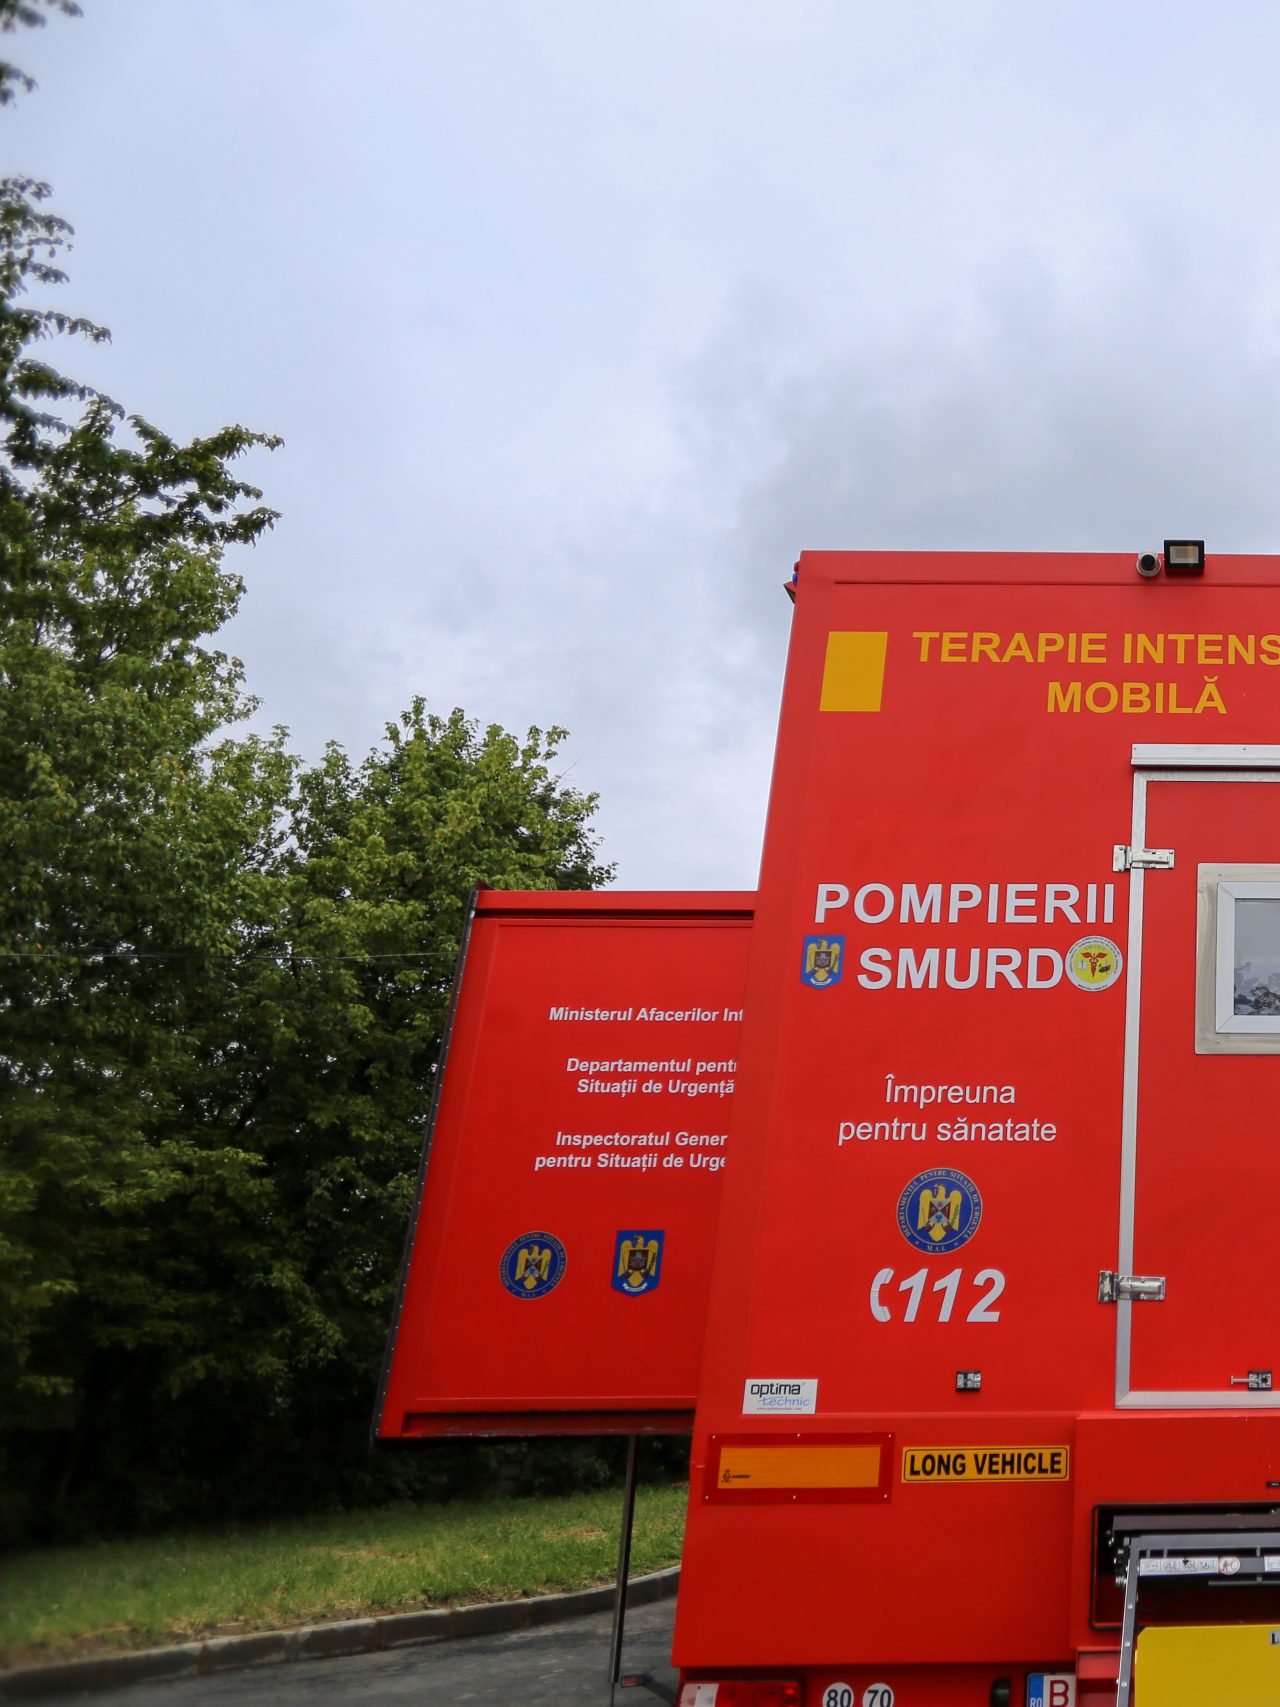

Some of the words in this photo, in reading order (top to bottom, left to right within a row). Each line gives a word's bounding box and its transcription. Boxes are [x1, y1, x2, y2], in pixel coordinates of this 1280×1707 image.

[912, 631, 1107, 663] TERAPIE
[1047, 676, 1227, 714] MOBILĂ
[814, 883, 1115, 924] POMPIERII
[857, 947, 1064, 990] SMURD
[549, 1007, 632, 1021] Ministerul
[636, 1008, 719, 1021] Afacerilor
[566, 1058, 691, 1075] Departamentul
[577, 1079, 637, 1098] Situații
[641, 1080, 663, 1093] de
[668, 1079, 735, 1097] Urgență
[885, 1073, 1016, 1109] Împreuna
[556, 1131, 670, 1149] Inspectoratul
[838, 1117, 927, 1146] pentru
[936, 1117, 1057, 1142] sănatate
[534, 1156, 592, 1171] pentru
[597, 1153, 658, 1172] Situații
[662, 1153, 684, 1168] de
[898, 1268, 1006, 1323] 112
[750, 1383, 801, 1398] optima
[758, 1396, 810, 1407] technic
[910, 1454, 966, 1476] LONG
[974, 1452, 1062, 1475] VEHICLE
[826, 1688, 852, 1707] 80
[867, 1689, 892, 1707] 70
[1049, 1680, 1070, 1707] B
